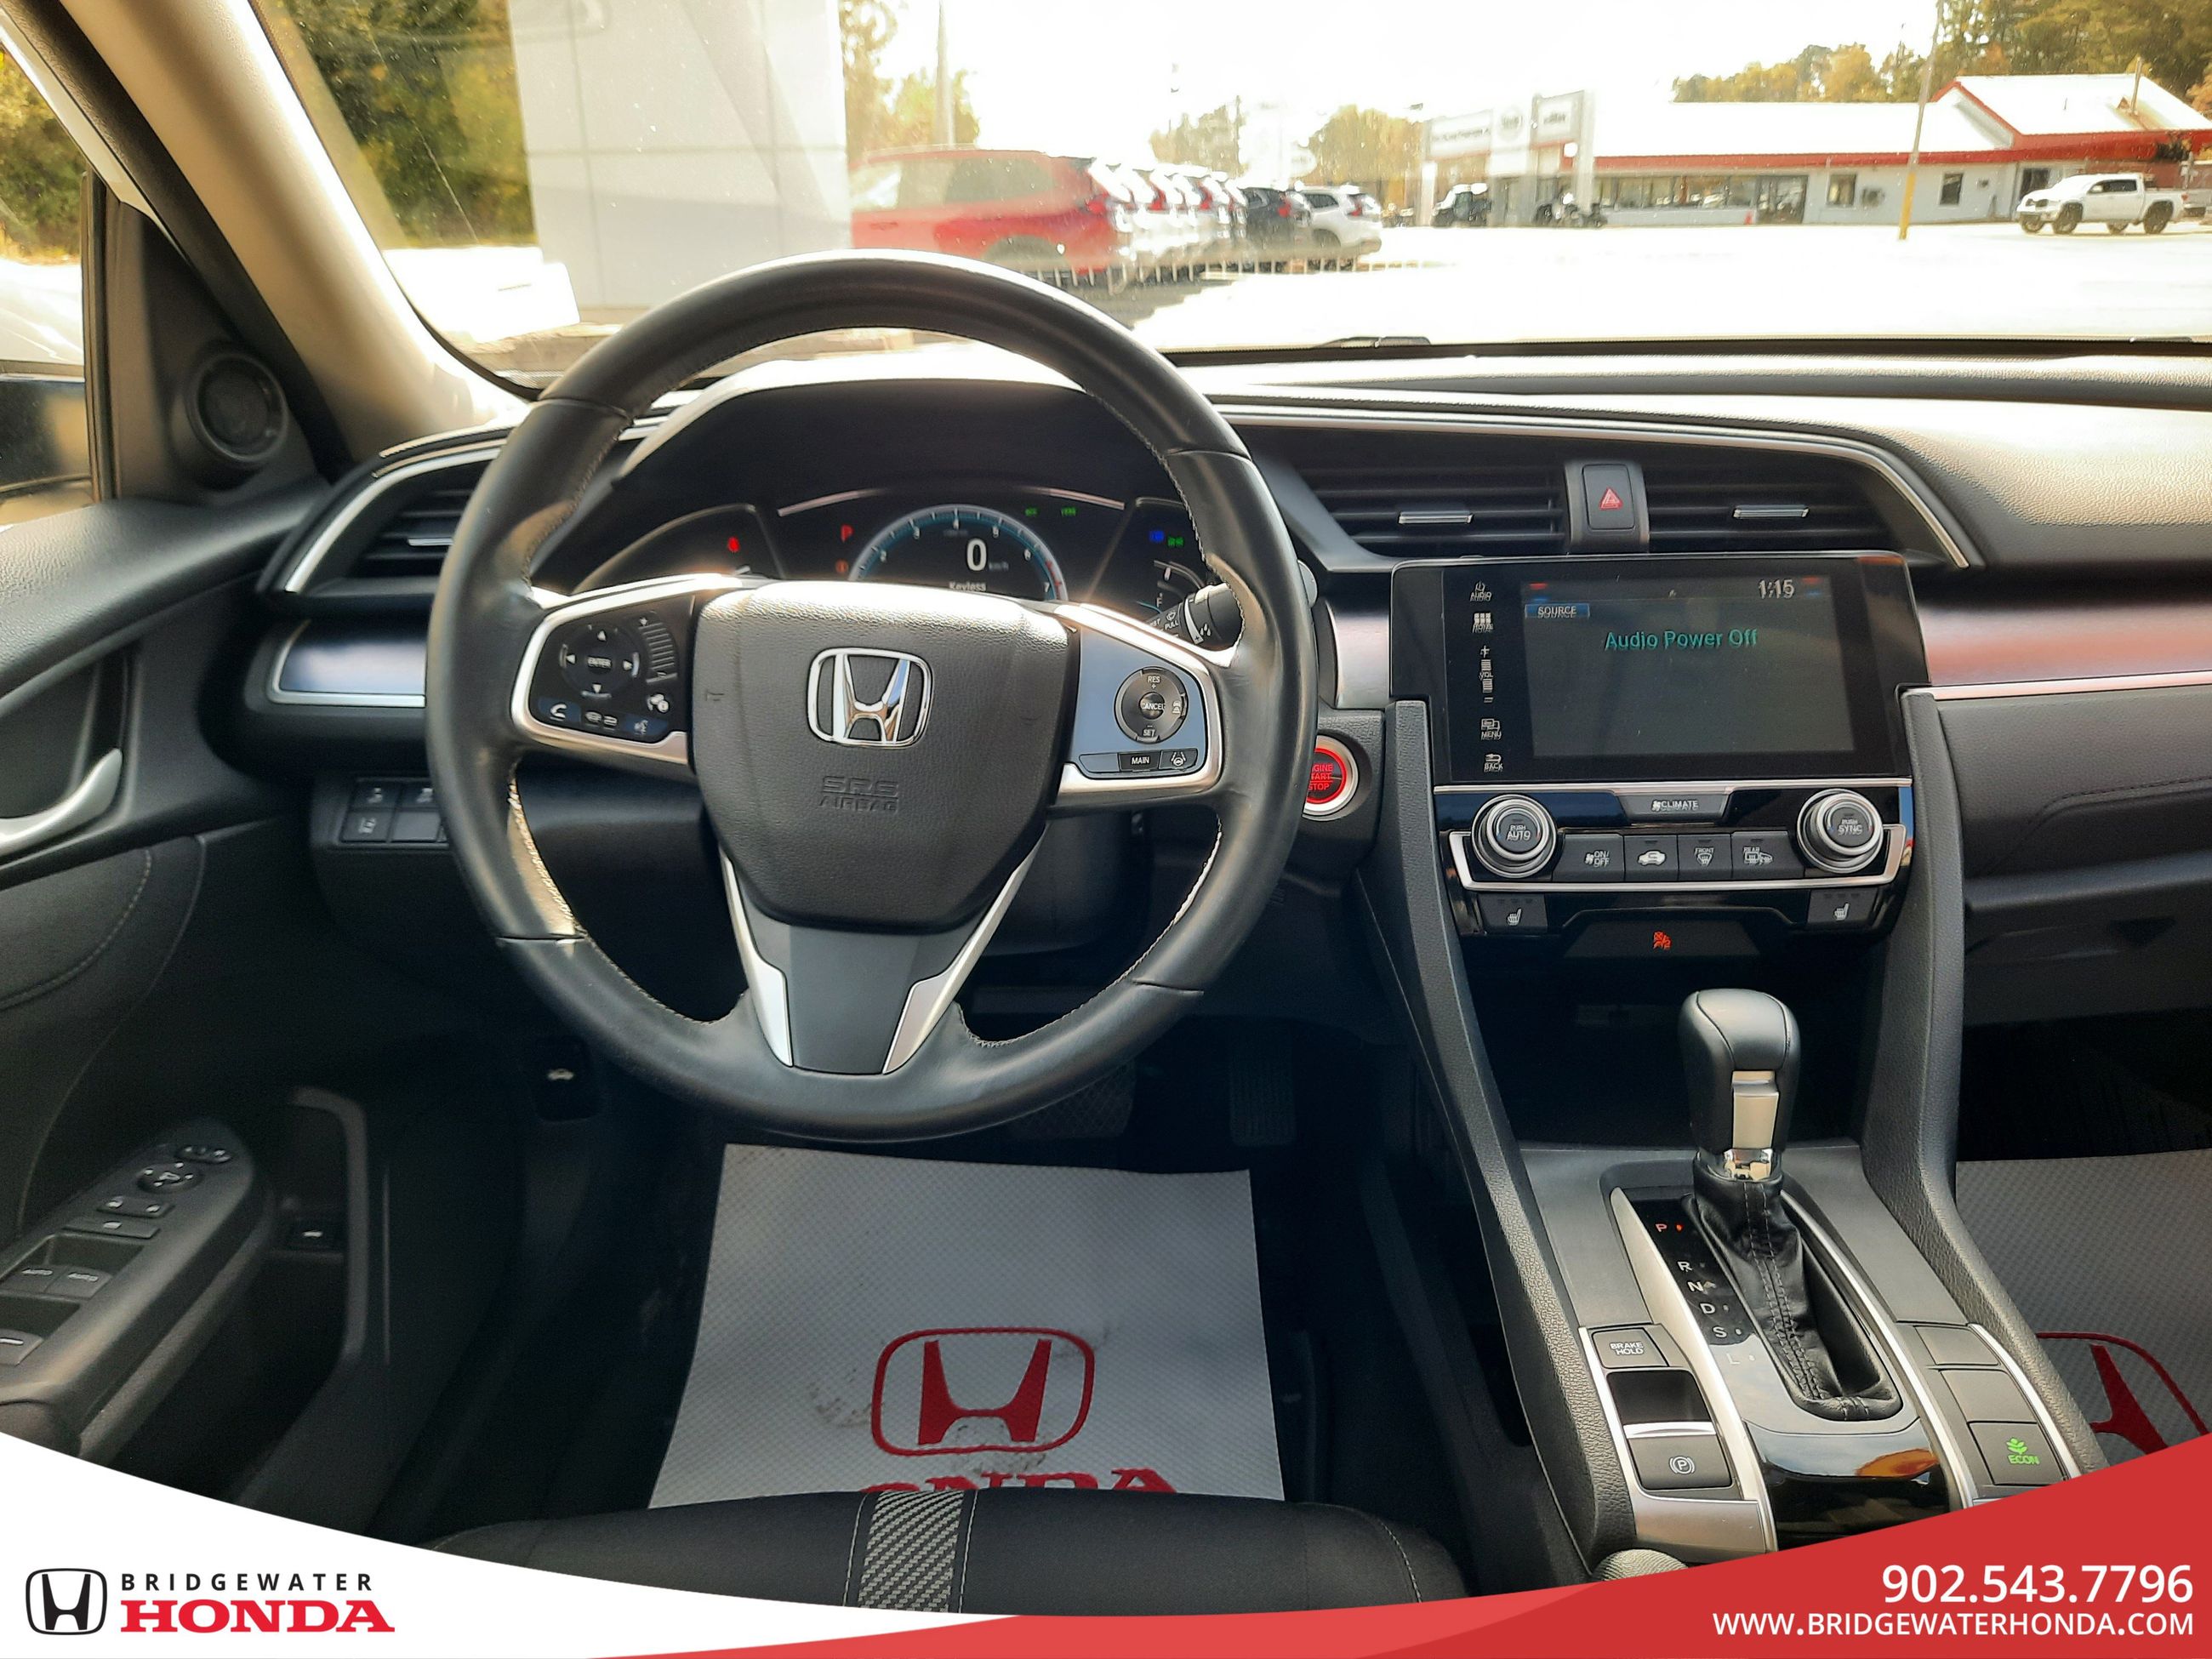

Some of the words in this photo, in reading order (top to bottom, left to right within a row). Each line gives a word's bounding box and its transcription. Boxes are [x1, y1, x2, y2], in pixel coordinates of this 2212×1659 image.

[966, 538, 987, 571] 0
[949, 580, 987, 591] Keyless
[1759, 579, 1795, 598] 1:15
[1470, 591, 1492, 601] AUDIO
[1537, 605, 1577, 618] SOURCE
[1165, 619, 1180, 630] PULL
[1605, 630, 1658, 651] Audio
[1663, 630, 1723, 649] Power
[1728, 628, 1758, 647] Off
[1143, 729, 1156, 738] SET
[1481, 732, 1502, 740] MENU
[1132, 756, 1149, 765] MAIN
[1484, 762, 1503, 772] BACK
[1661, 800, 1698, 810] CLIMATE
[1506, 830, 1531, 841] AUTO
[1838, 824, 1863, 836] SYNC
[1593, 858, 1610, 868] OFF
[1656, 1223, 1668, 1232] P
[1677, 1261, 1693, 1272] R
[1687, 1280, 1704, 1292] N
[1700, 1303, 1716, 1314] D
[1713, 1325, 1728, 1338] S
[2007, 1455, 2040, 1465] ECON
